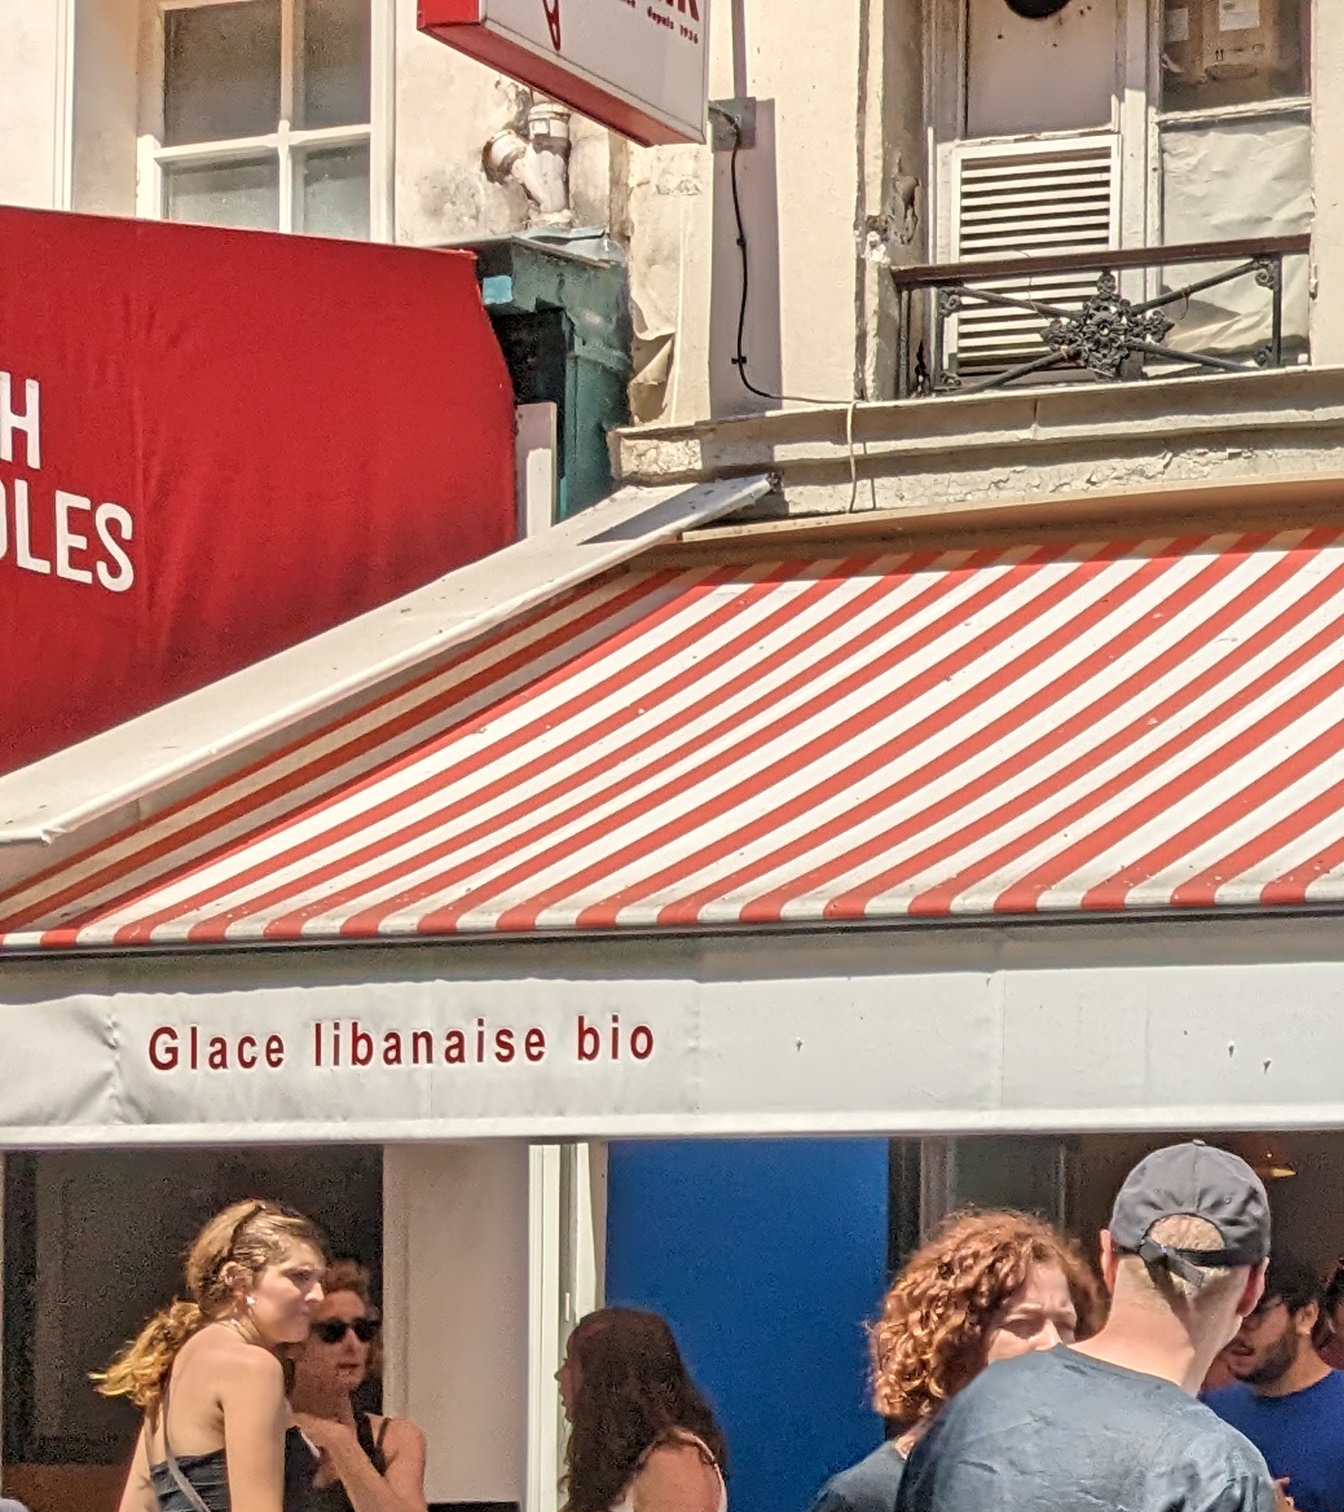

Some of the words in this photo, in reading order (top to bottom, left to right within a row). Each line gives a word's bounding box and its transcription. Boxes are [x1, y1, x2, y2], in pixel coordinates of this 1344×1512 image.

[0, 479, 135, 593] LES
[147, 1024, 286, 1072] Glace
[313, 1016, 546, 1068] libanaise
[576, 1012, 655, 1062] bio
